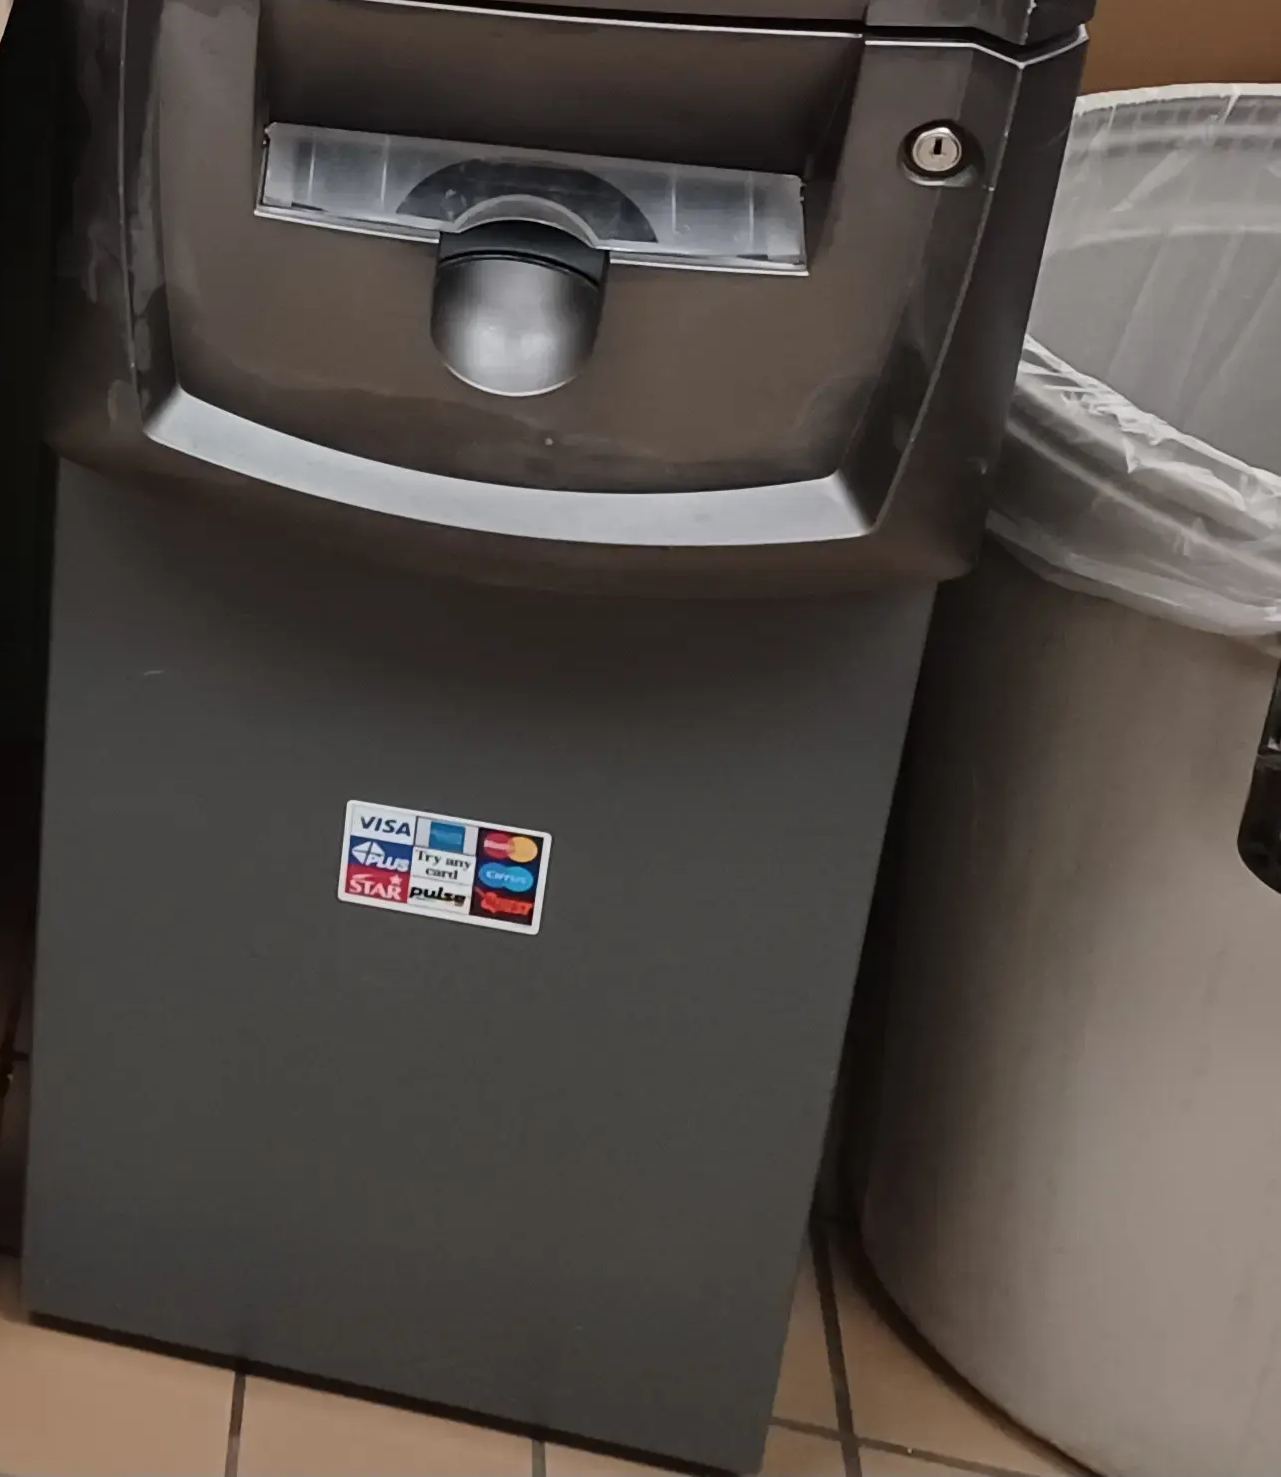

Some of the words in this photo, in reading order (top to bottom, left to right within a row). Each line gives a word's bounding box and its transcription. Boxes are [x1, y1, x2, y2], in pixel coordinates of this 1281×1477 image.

[360, 816, 412, 838] VISA
[365, 853, 410, 873] PLUS
[416, 849, 442, 866] Try
[445, 857, 472, 872] any
[425, 867, 459, 881] card
[348, 874, 403, 901] STAR
